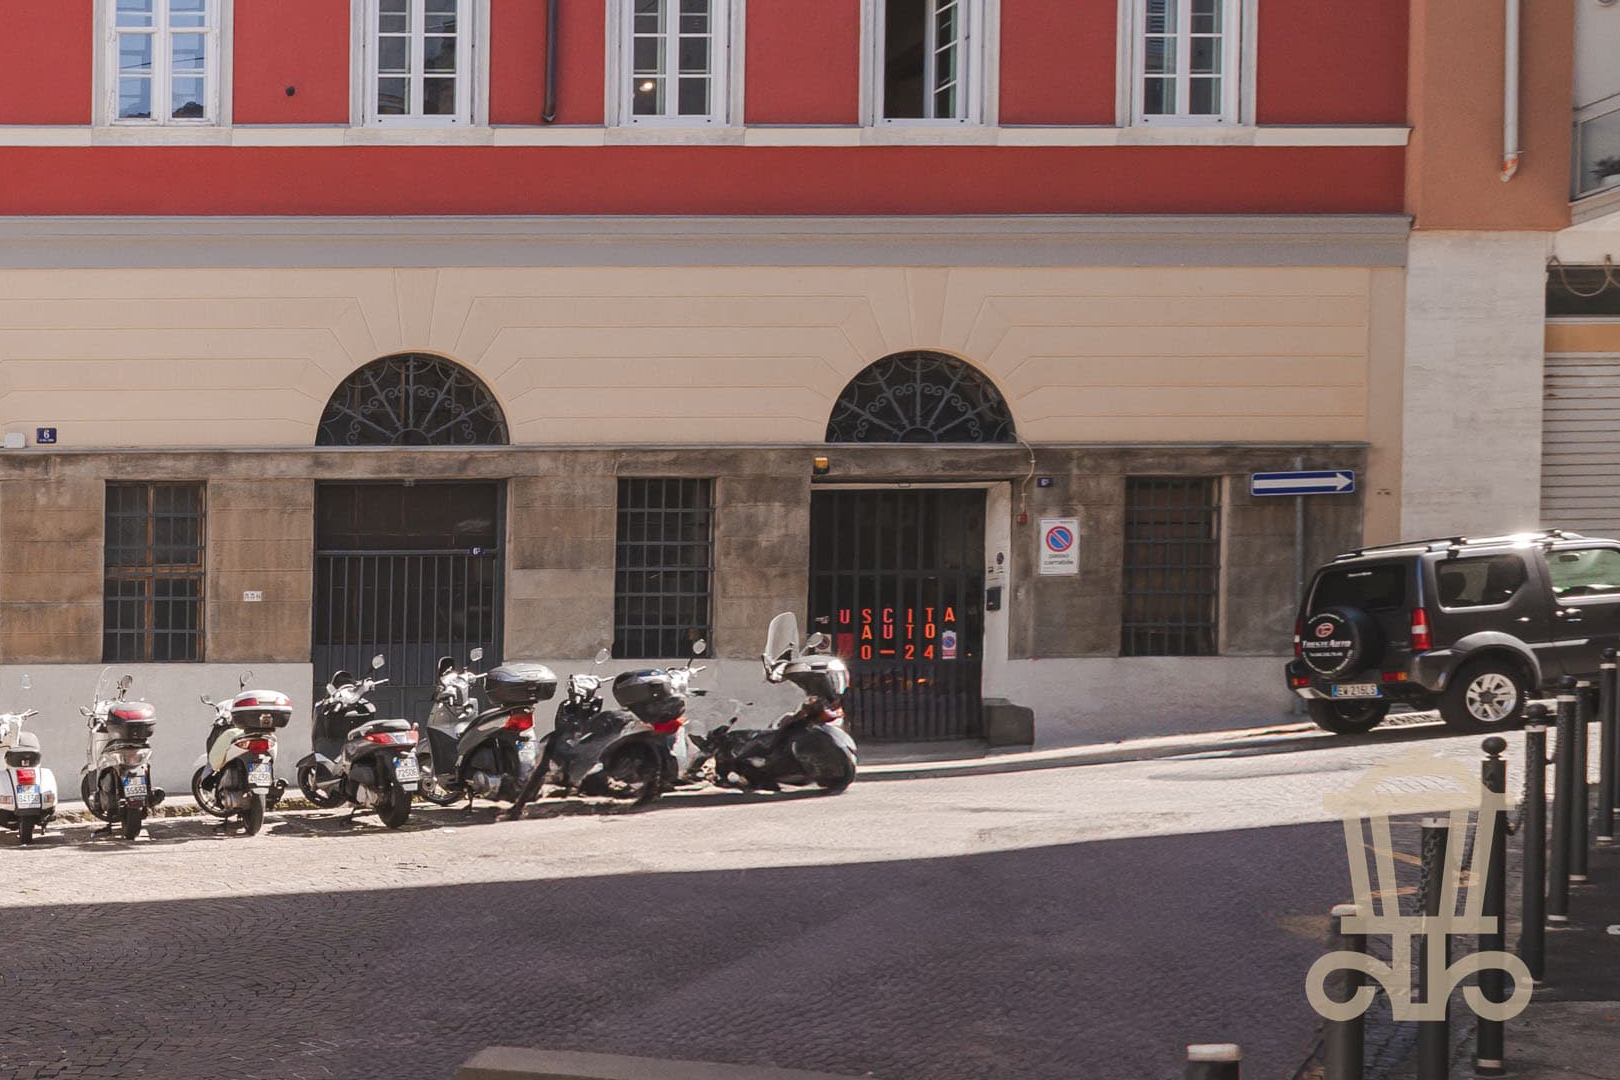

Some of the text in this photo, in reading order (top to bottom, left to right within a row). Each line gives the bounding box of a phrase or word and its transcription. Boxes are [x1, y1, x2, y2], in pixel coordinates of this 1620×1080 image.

[43, 429, 50, 439] 6
[839, 607, 956, 624] USCITA
[861, 623, 936, 640] AUTO
